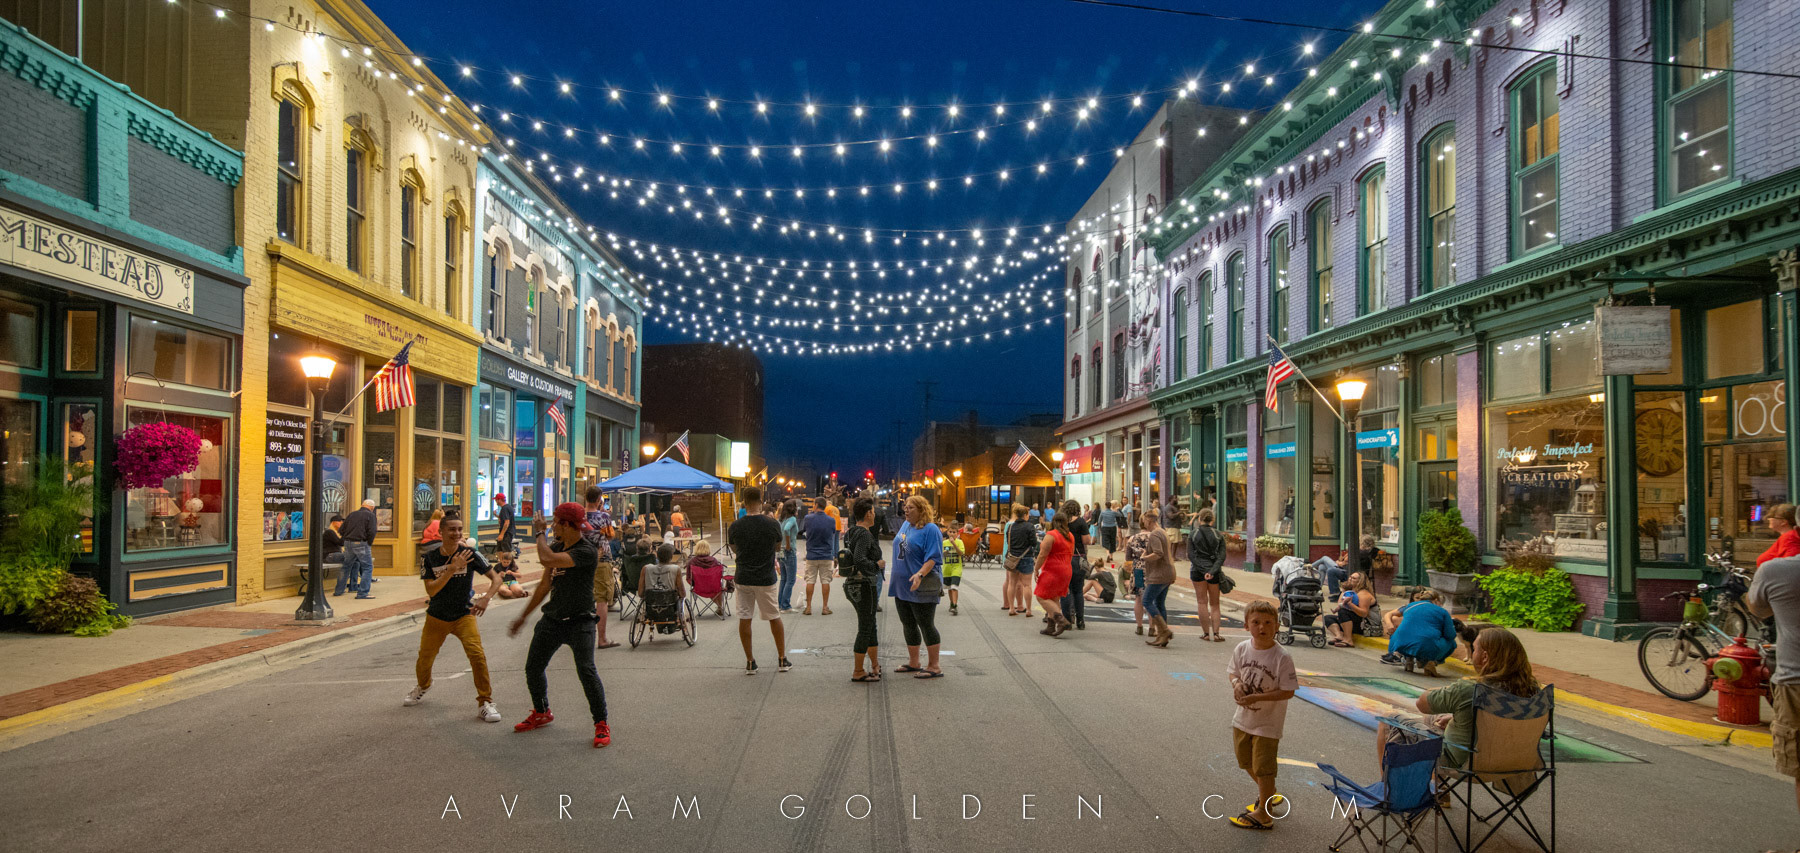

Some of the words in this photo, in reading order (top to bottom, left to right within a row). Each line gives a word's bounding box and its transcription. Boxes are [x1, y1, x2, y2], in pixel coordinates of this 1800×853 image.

[508, 367, 529, 384] GALLERY
[530, 376, 534, 386] &
[535, 377, 554, 394] CUSTOM
[554, 386, 572, 400] FRAMING
[275, 430, 294, 438] Different
[270, 442, 282, 452] 893
[288, 443, 302, 452] 5010
[1496, 445, 1538, 462] Perfectly
[1542, 442, 1593, 458] Imperfect
[271, 476, 282, 484] Daily
[1507, 471, 1579, 482] CREATIONS
[288, 488, 305, 496] Parking
[322, 502, 340, 512] DELI
